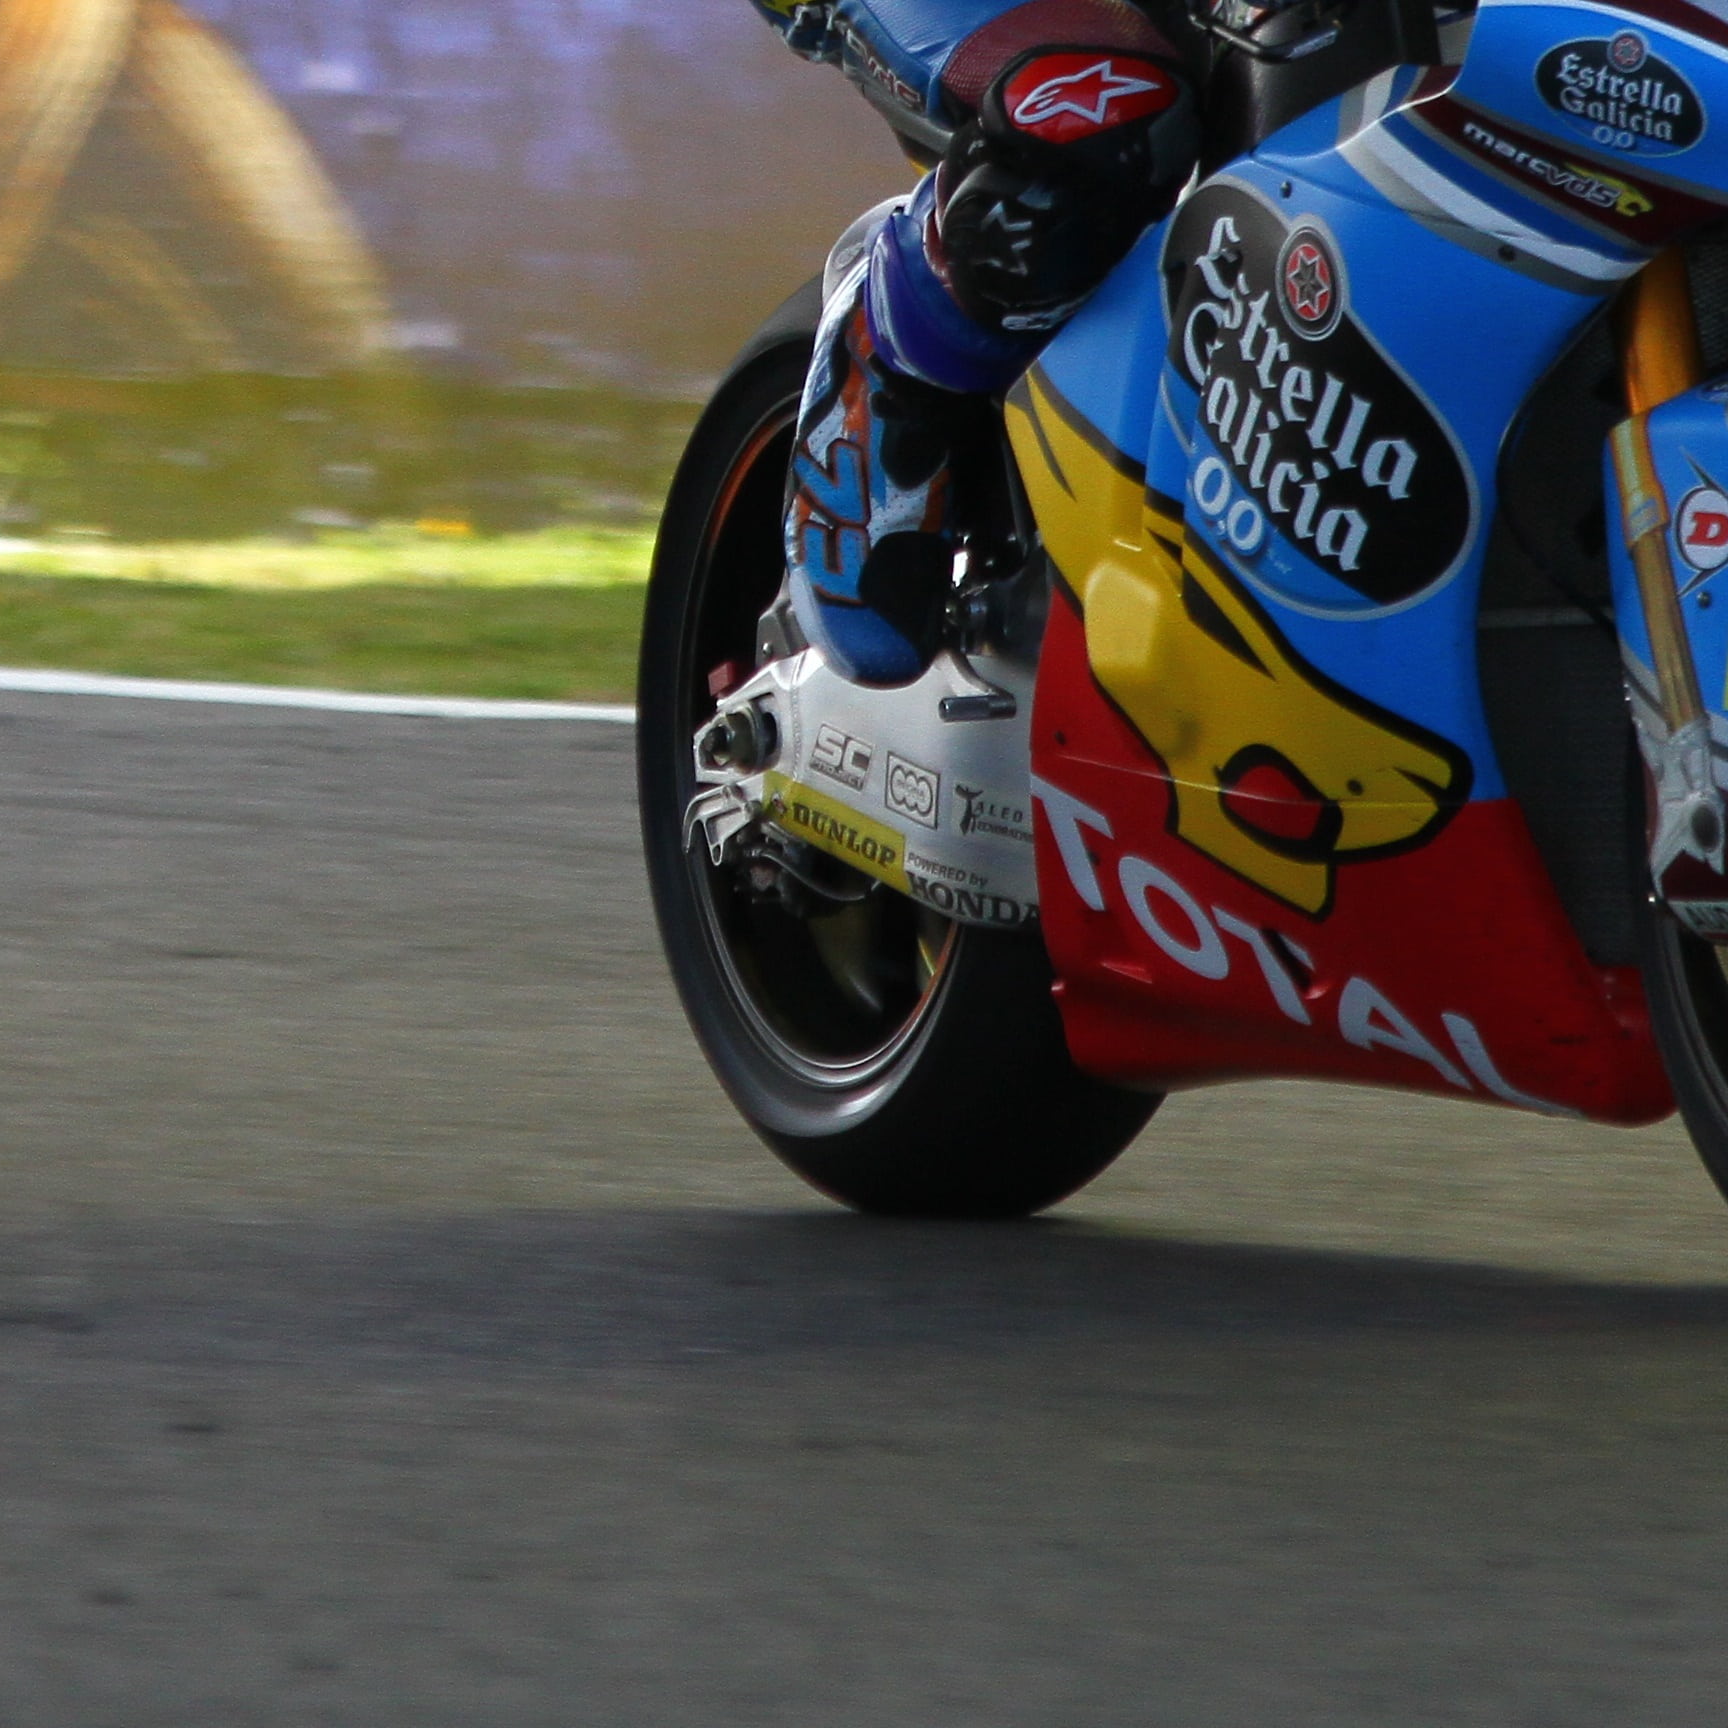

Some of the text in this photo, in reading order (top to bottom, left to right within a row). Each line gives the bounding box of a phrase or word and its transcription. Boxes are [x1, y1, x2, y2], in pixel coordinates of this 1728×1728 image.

[1556, 53, 1683, 116] Estrella
[1560, 86, 1673, 141] Galicia
[1195, 217, 1419, 501] Estrella
[1184, 302, 1369, 572] Galicia
[813, 725, 872, 776] SC
[793, 802, 897, 868] DUNLOP
[905, 870, 1040, 923] HONDA
[908, 852, 966, 882] POWERED
[1030, 775, 1587, 1118] TOTAL
